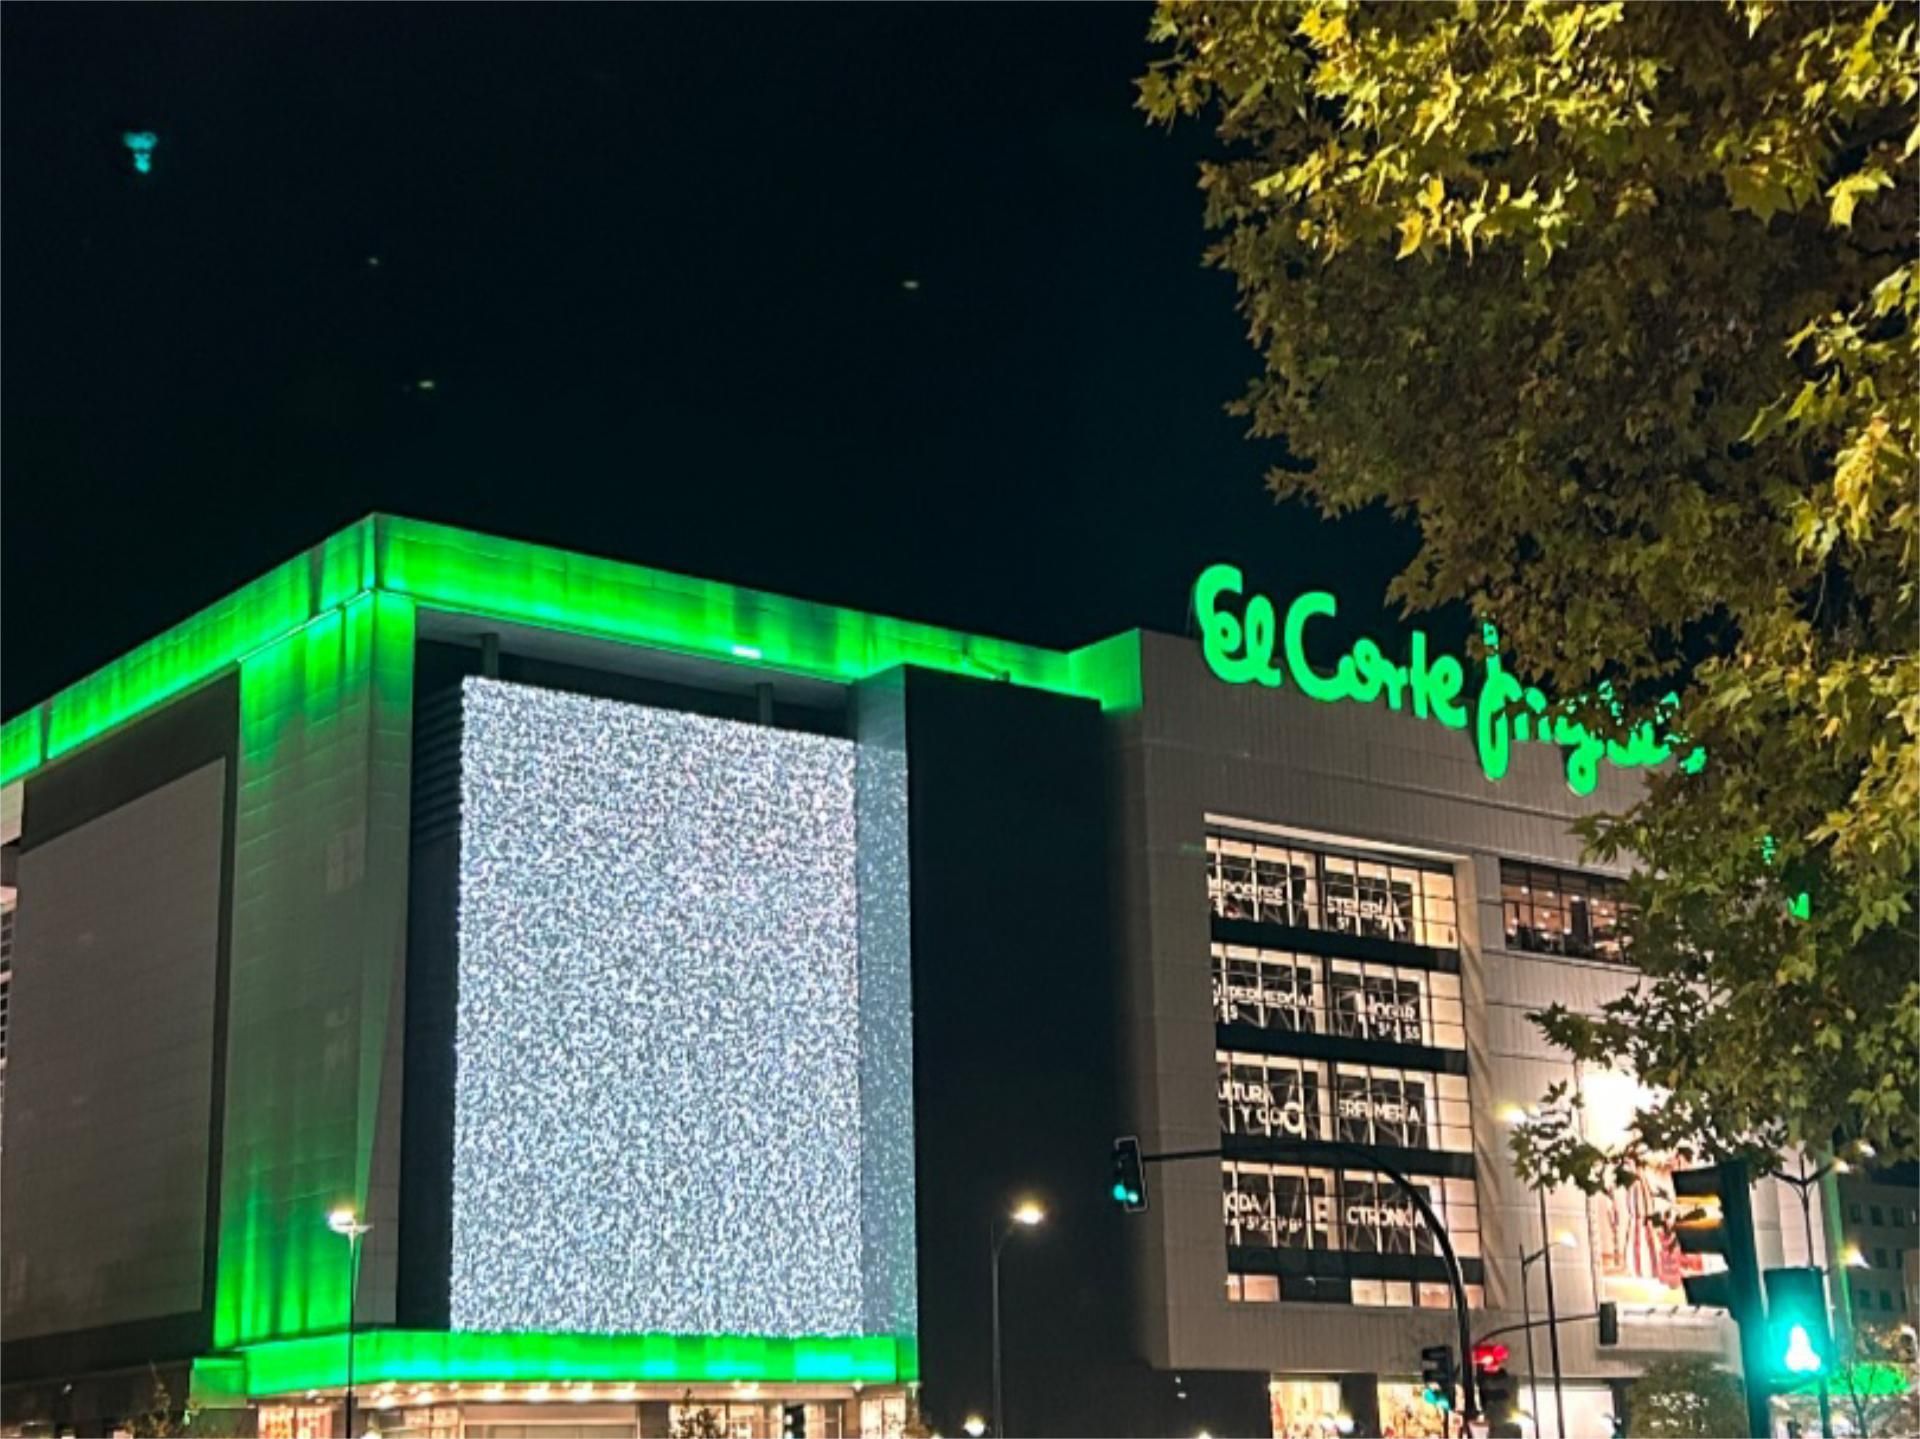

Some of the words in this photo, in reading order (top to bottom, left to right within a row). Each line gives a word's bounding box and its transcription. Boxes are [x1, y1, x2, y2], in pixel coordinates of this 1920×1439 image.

[1194, 563, 1282, 687] El
[1284, 591, 1468, 729] Corte
[1218, 1081, 1275, 1104] ULTURA
